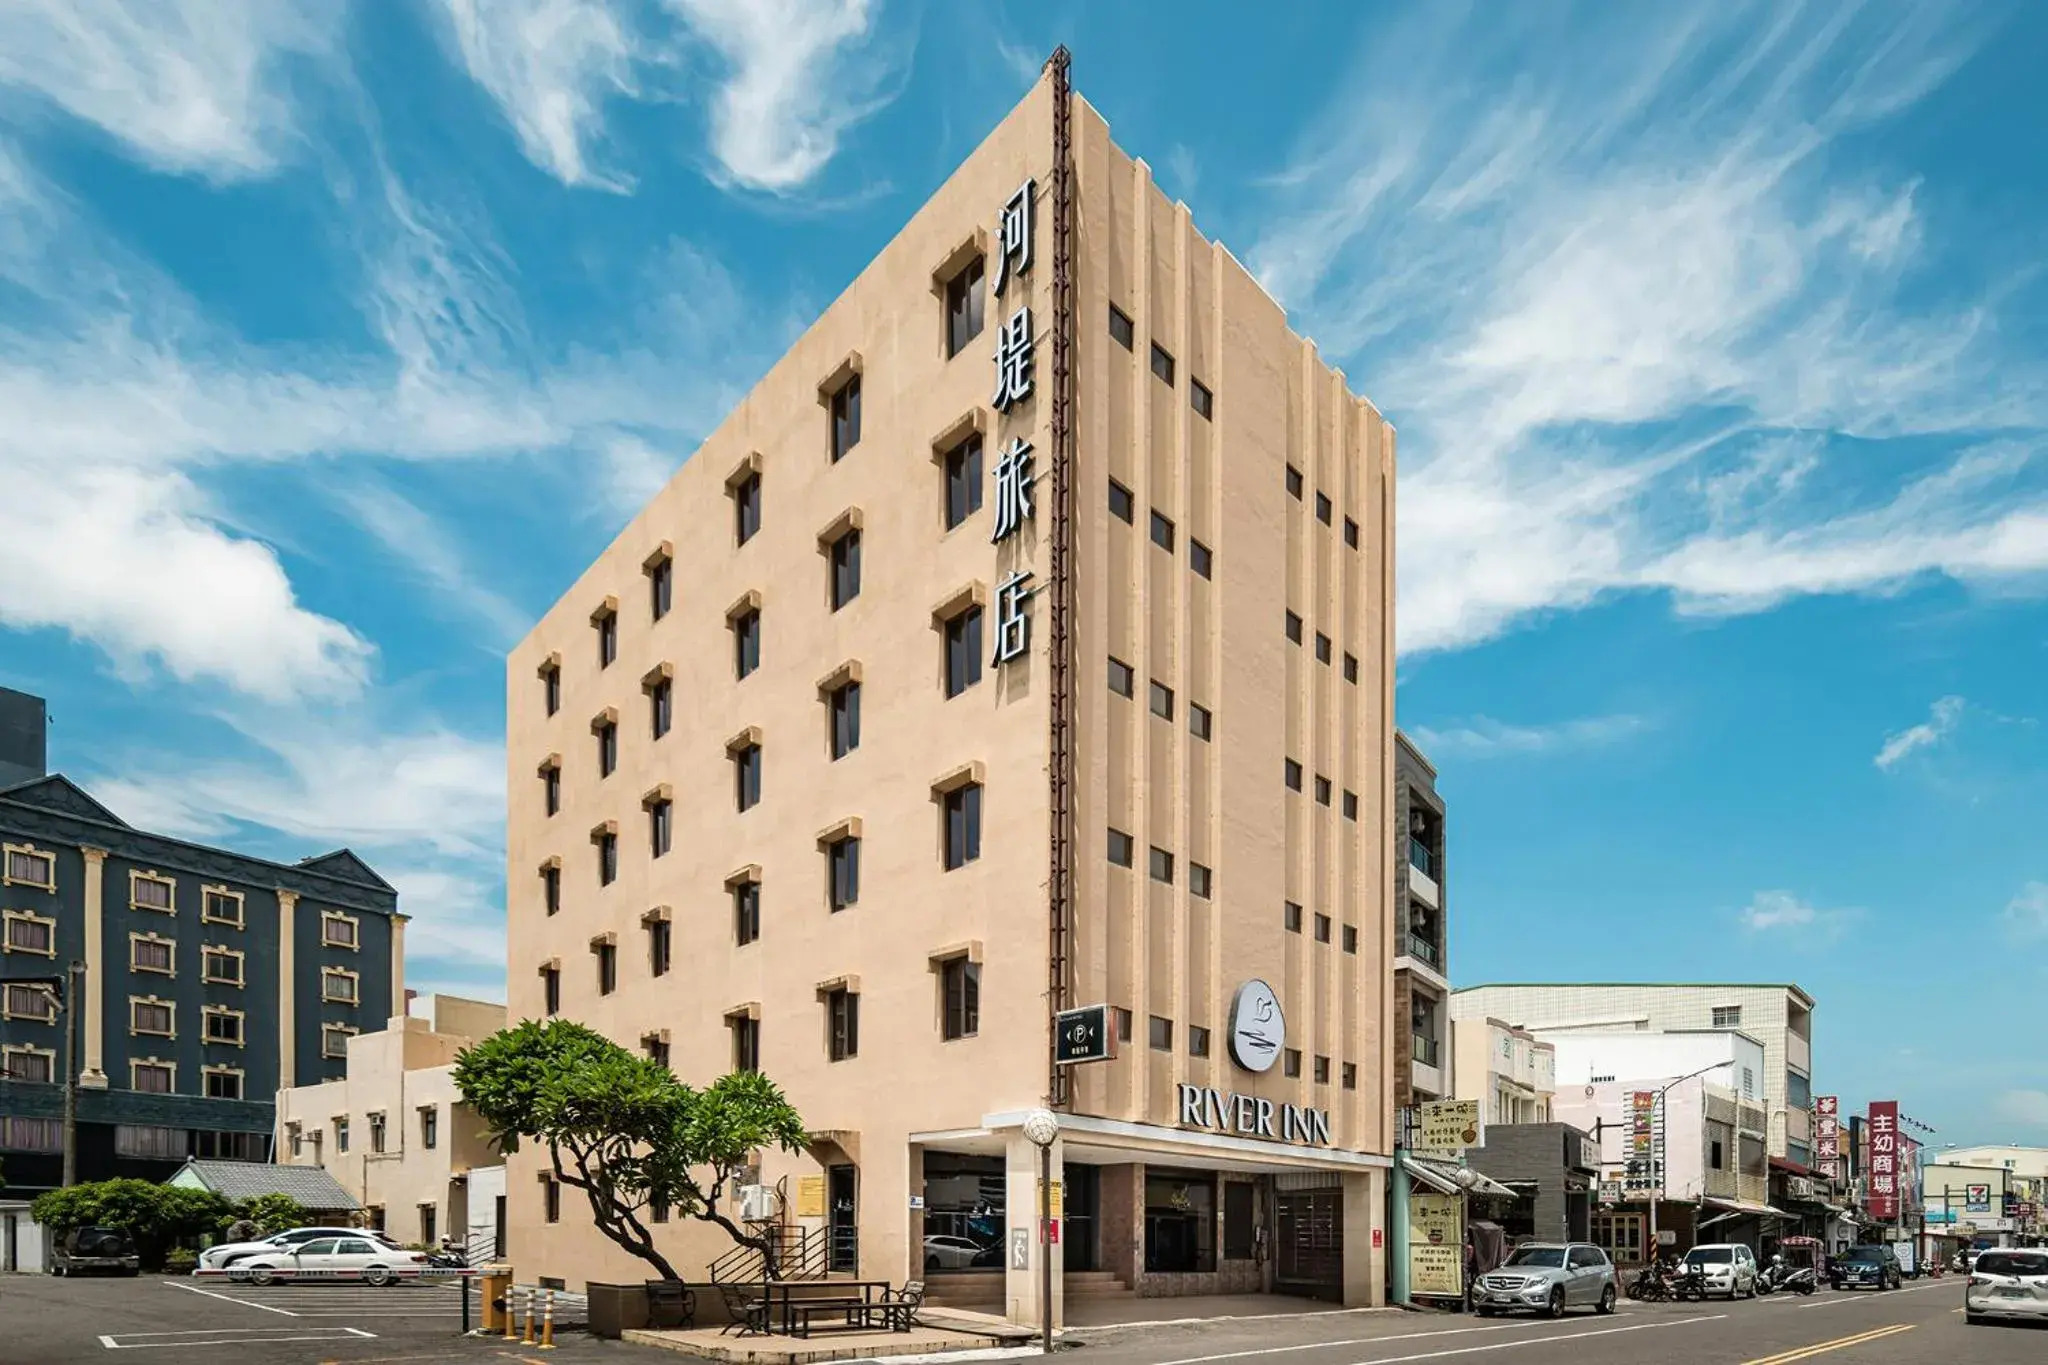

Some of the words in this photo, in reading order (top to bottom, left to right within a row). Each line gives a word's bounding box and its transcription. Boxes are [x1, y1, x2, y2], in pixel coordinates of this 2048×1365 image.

[992, 177, 1036, 667] 河堤旅店
[1179, 1083, 1276, 1137] RIVER
[1282, 1103, 1330, 1145] INN
[1872, 1114, 1894, 1195] 主幼商場
